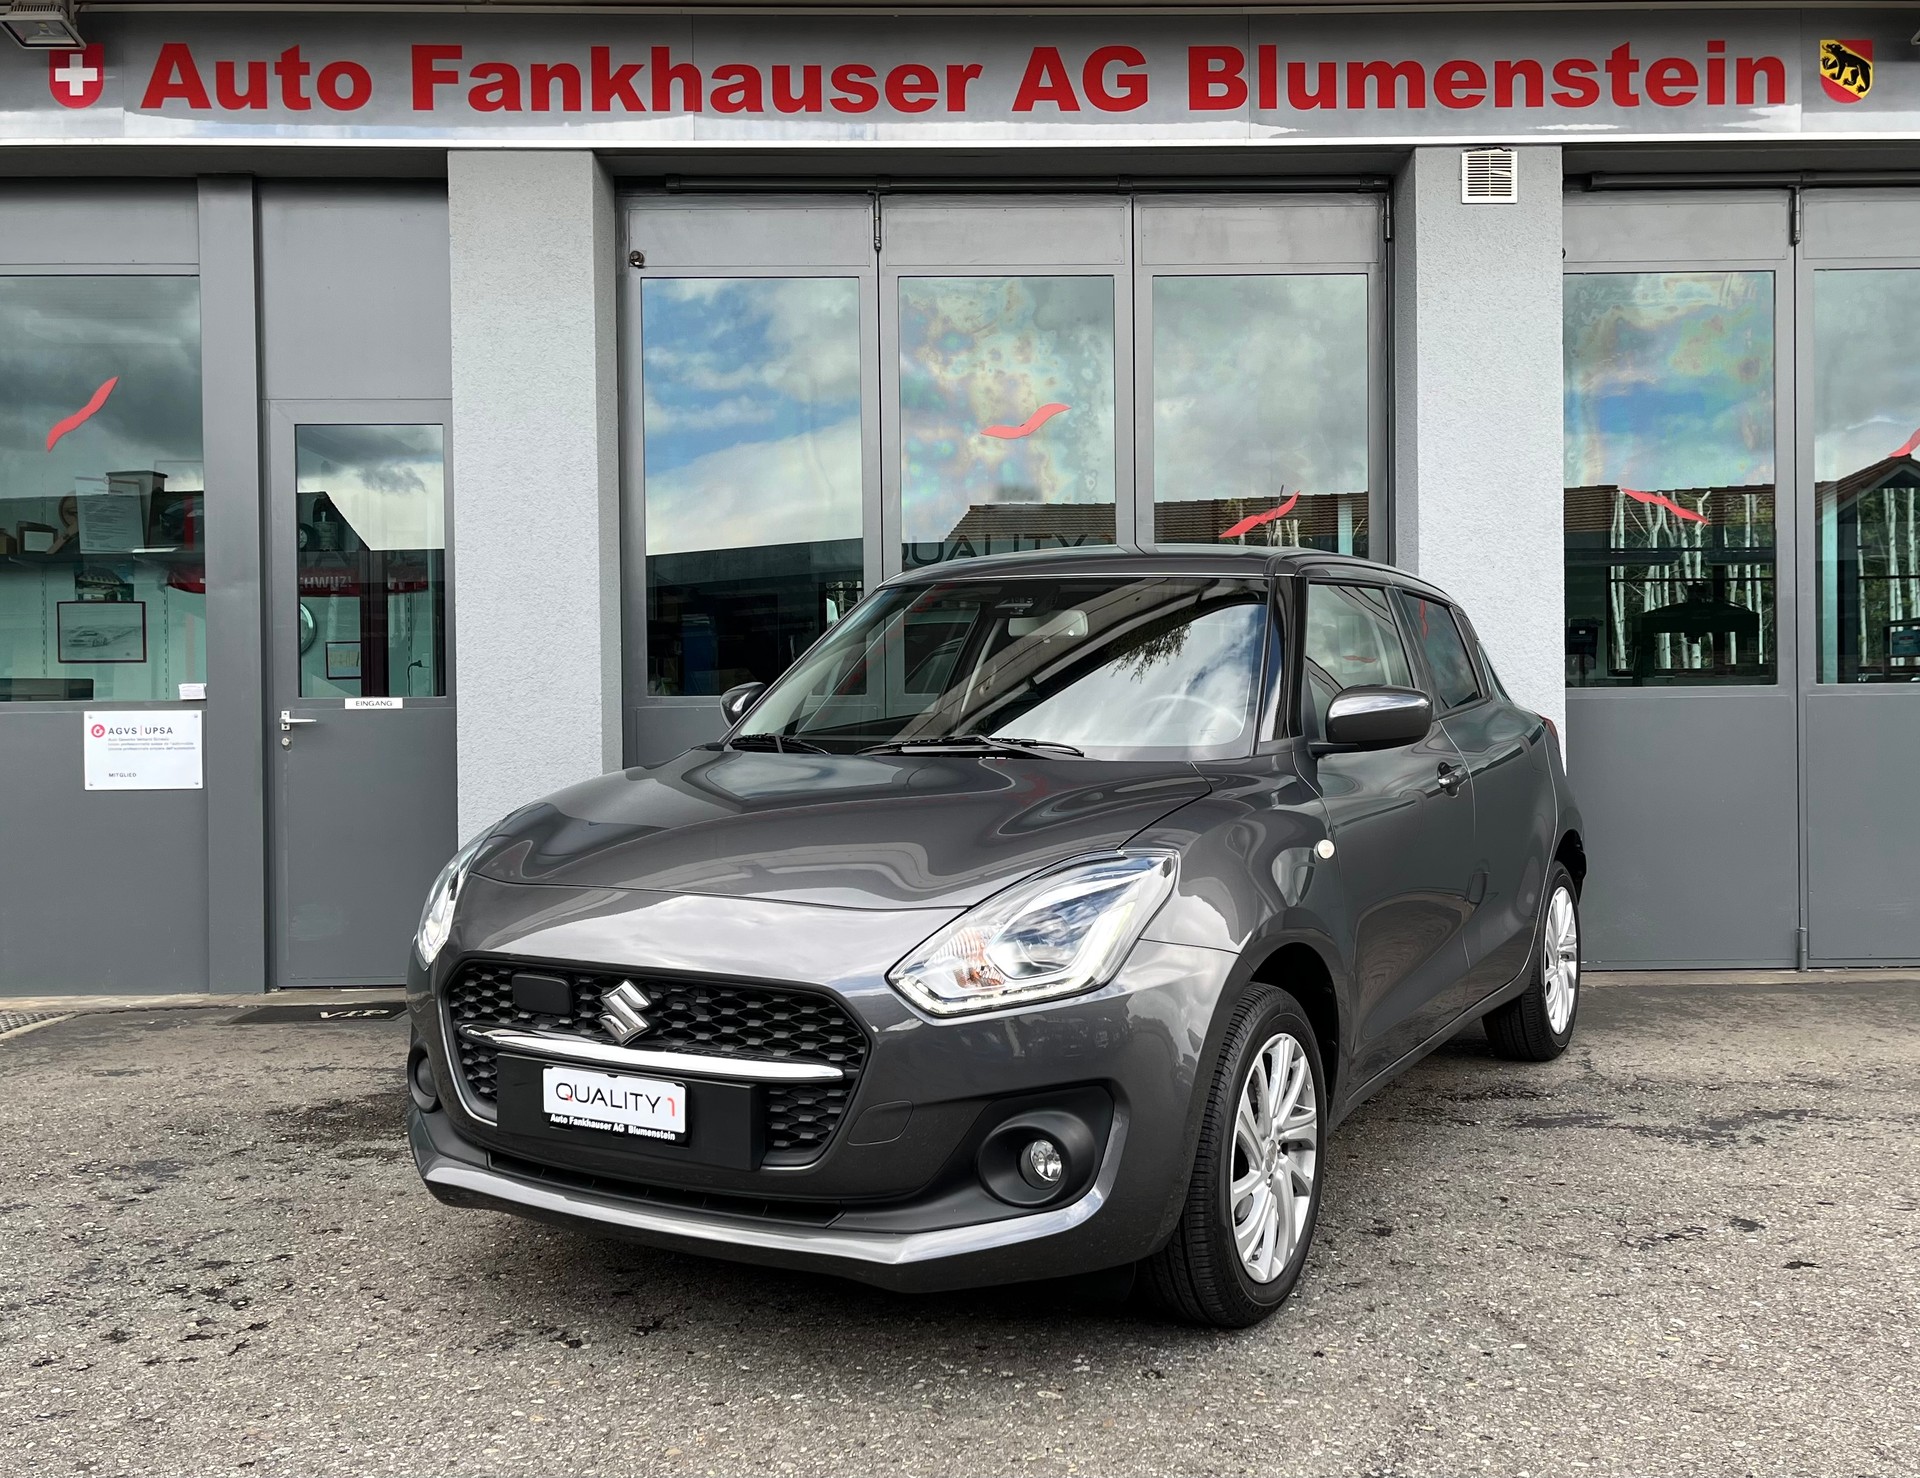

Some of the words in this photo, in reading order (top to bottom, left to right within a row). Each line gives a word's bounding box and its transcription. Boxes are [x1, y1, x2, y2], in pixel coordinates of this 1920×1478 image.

[142, 45, 371, 110] Auto
[412, 47, 983, 113] Fankhauser
[1012, 47, 1149, 113] AG
[1188, 42, 1786, 111] Blumenstein
[108, 727, 137, 735] AGVS
[144, 726, 174, 735] UPSA
[555, 1082, 661, 1114] QUALITY
[667, 1097, 675, 1117] 1
[550, 1113, 568, 1125] Auto
[568, 1116, 612, 1132] Fankhauser
[612, 1122, 625, 1133] AG
[628, 1125, 676, 1141] Blumenstein
